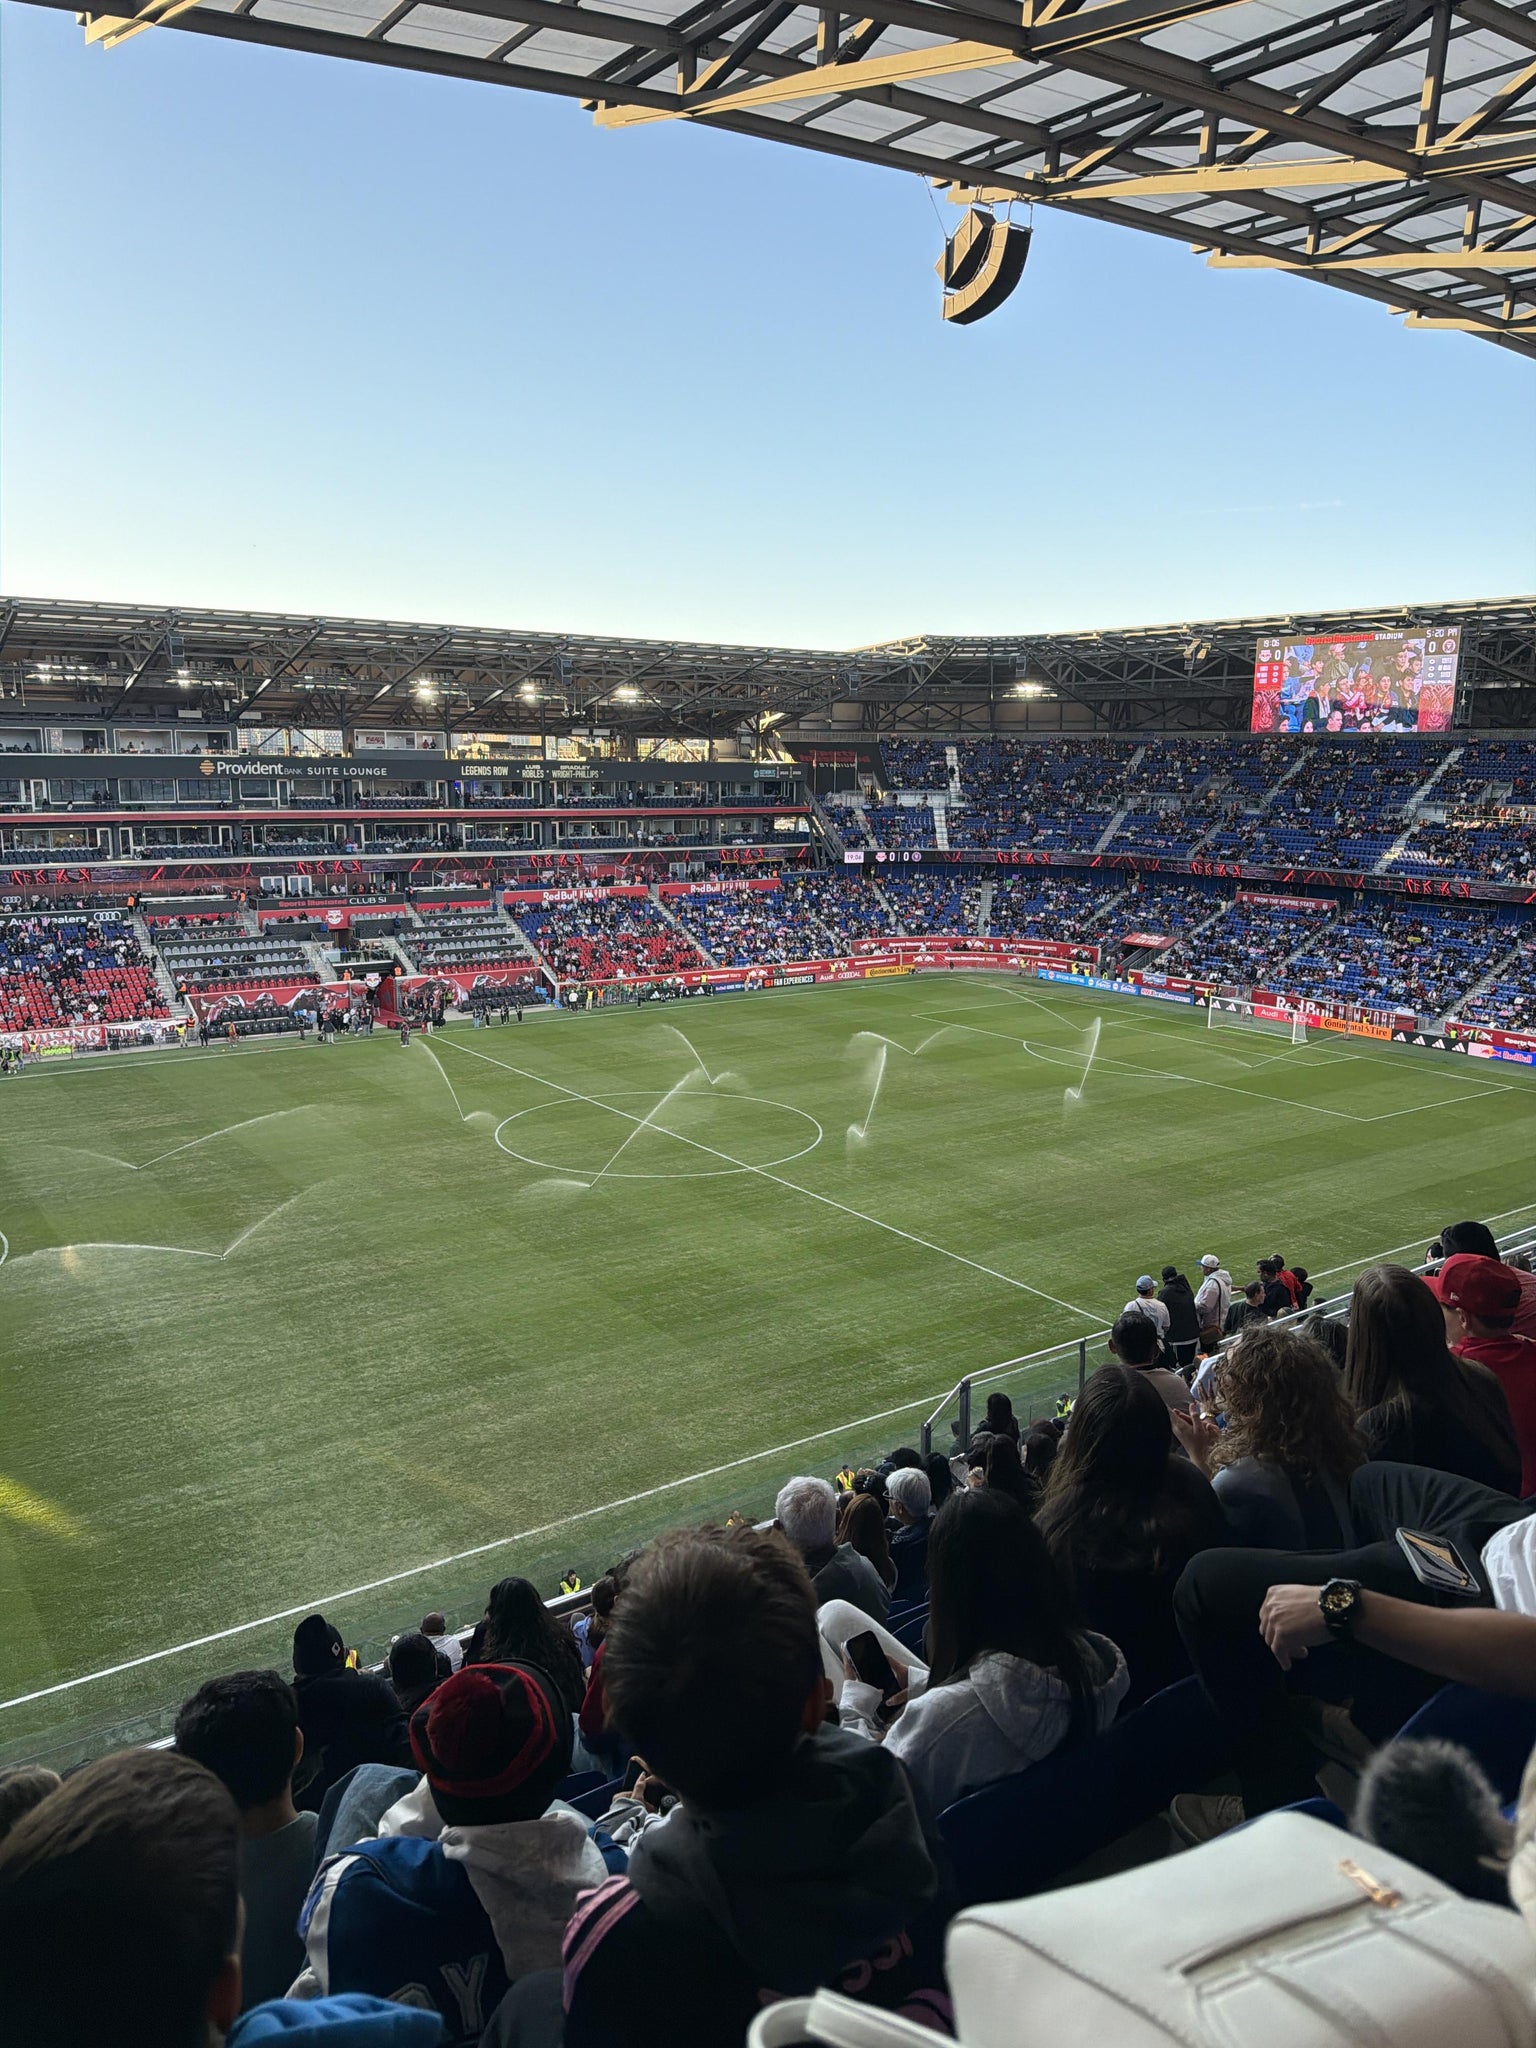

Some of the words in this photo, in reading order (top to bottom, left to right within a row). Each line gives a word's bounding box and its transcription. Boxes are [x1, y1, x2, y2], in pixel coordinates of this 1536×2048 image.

[1375, 632, 1403, 641] STADIUM
[1426, 629, 1444, 638] 5:20
[1429, 641, 1436, 653] 0
[1274, 649, 1281, 661] 0
[217, 761, 283, 775] Provident
[307, 767, 339, 776] SUITE
[343, 767, 388, 776] LOUNGE
[461, 766, 492, 776] LEGENDS
[493, 766, 509, 776] ROW
[521, 769, 545, 778] ROBLES
[889, 851, 896, 862] 0
[903, 851, 910, 862] 0
[349, 897, 376, 905] CLUB
[378, 896, 387, 904] SI
[1280, 899, 1299, 907] EMPIRE
[44, 915, 87, 925] ealers
[783, 974, 814, 986] EXPERIENCES
[1260, 1009, 1279, 1018] Audi
